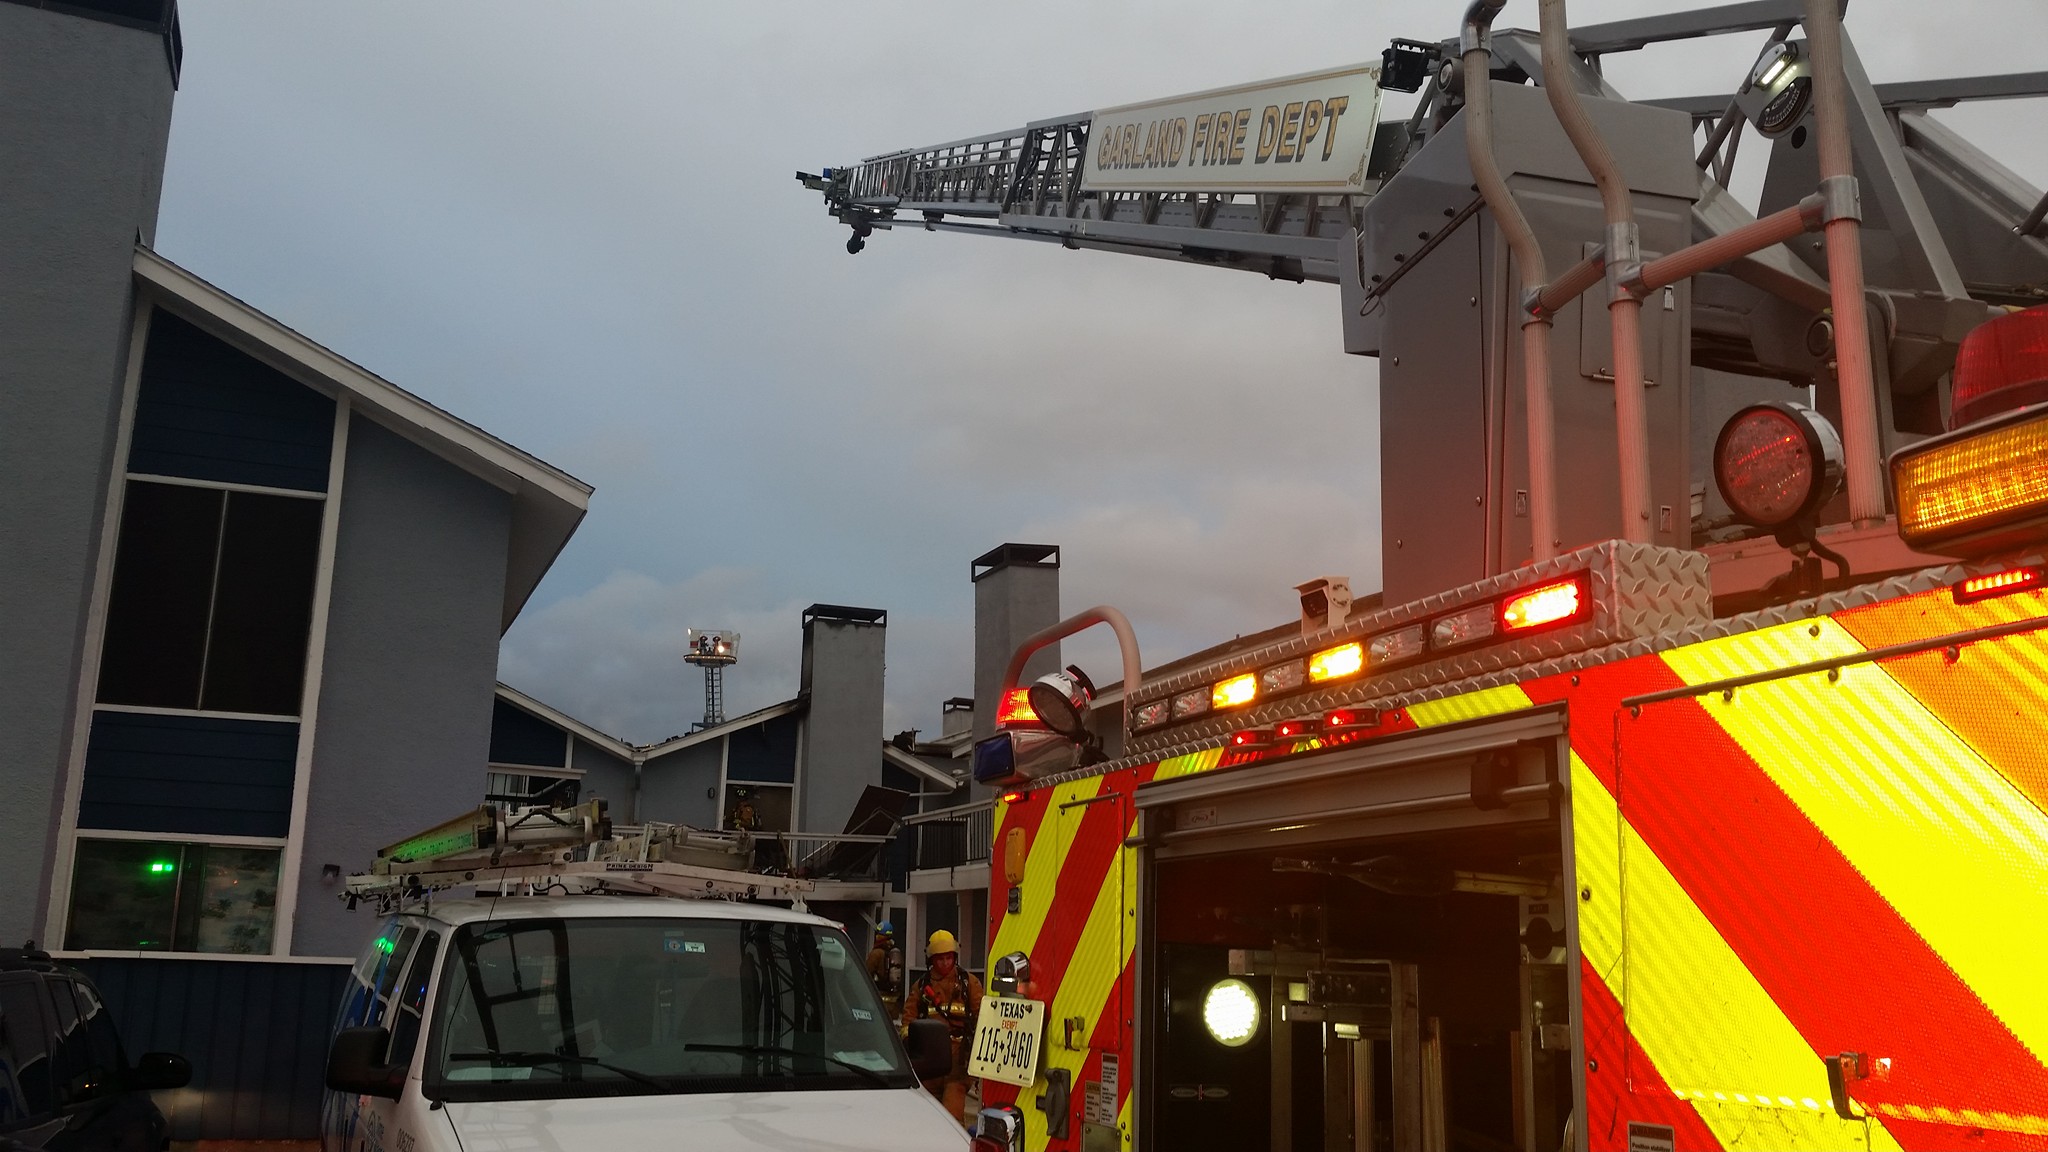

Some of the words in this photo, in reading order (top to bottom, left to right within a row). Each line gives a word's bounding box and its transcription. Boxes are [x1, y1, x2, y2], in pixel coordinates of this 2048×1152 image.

[1097, 117, 1187, 171] GARLAND
[1189, 108, 1252, 167] FIRE
[1254, 95, 1350, 165] DEPT
[1000, 1002, 1025, 1019] TEXAS
[1001, 1020, 1018, 1030] EXEMPT
